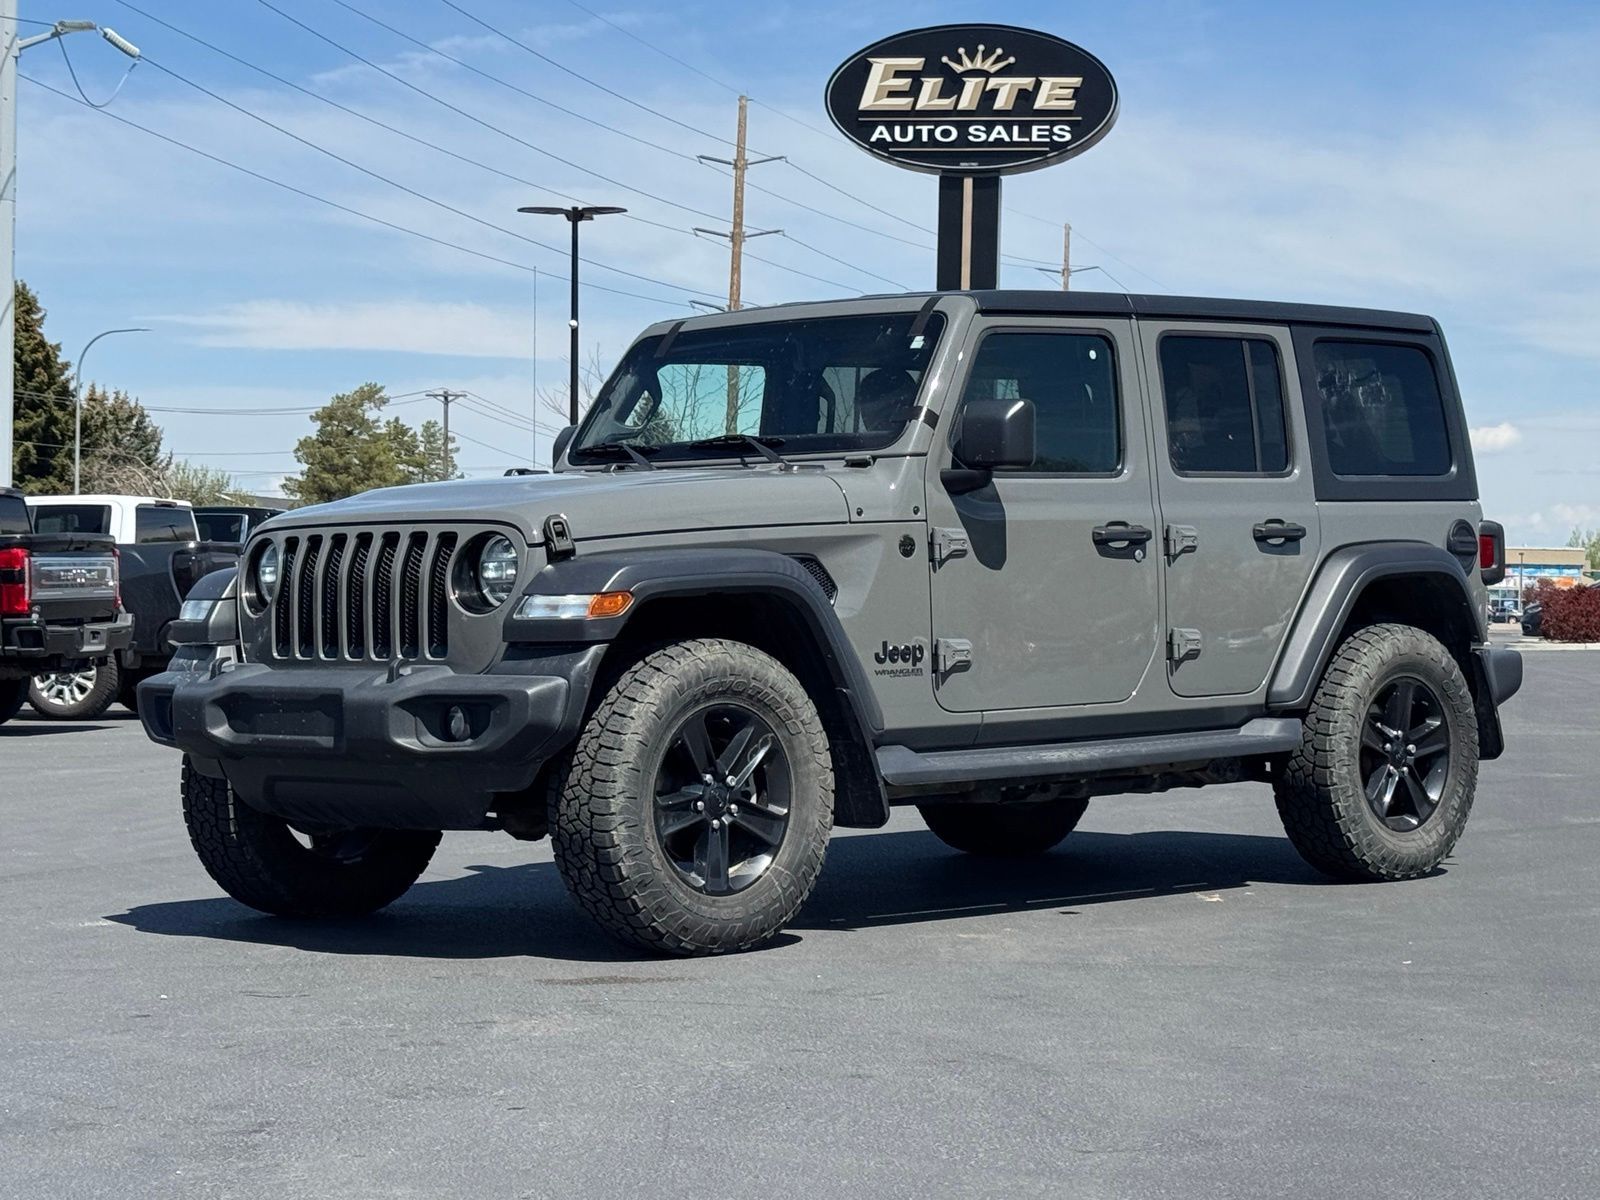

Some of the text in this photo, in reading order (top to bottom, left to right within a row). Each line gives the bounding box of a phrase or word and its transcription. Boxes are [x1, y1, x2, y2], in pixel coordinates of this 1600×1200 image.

[869, 125, 1072, 142] AUTO SALES
[874, 640, 924, 667] Jeep
